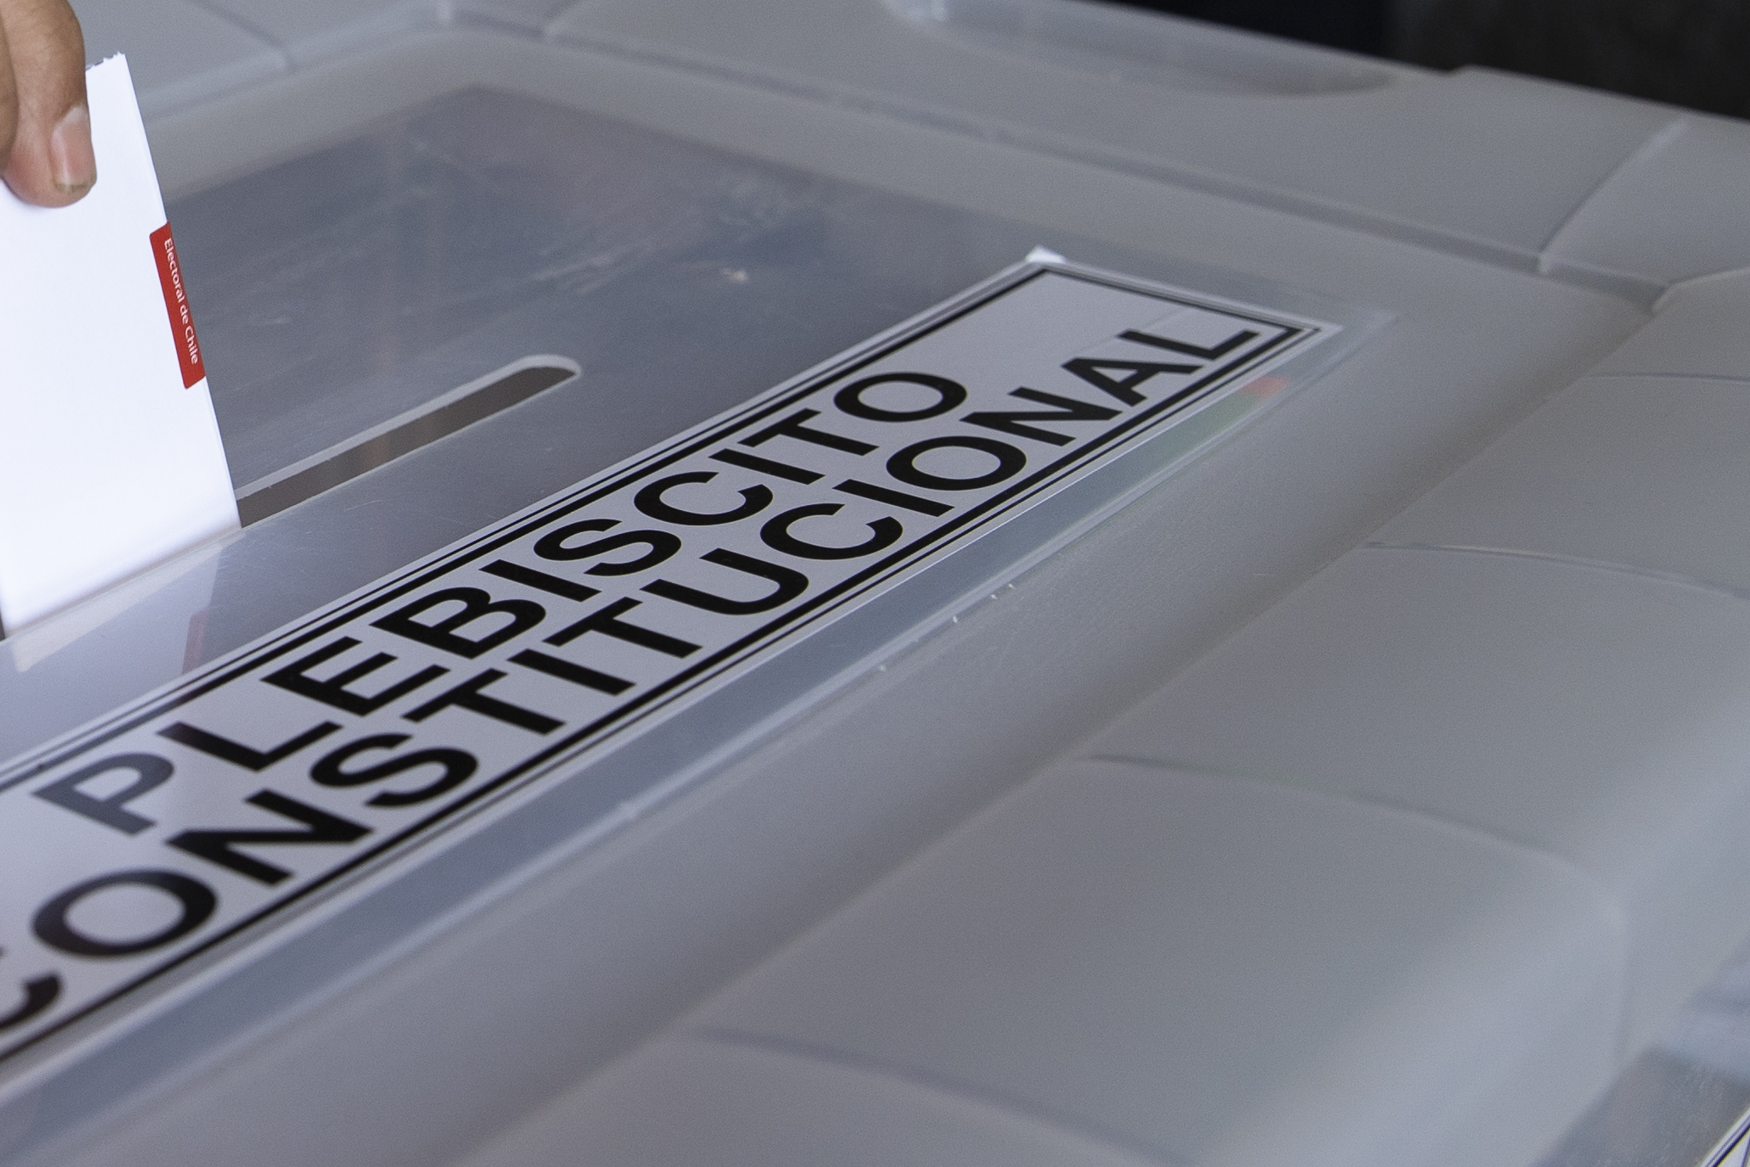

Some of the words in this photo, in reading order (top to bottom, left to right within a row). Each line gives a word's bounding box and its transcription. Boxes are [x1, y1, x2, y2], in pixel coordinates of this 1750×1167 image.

[163, 237, 186, 303] Electoral
[179, 304, 189, 325] de
[184, 325, 200, 365] Chile
[32, 370, 968, 836] PLEBISCITO
